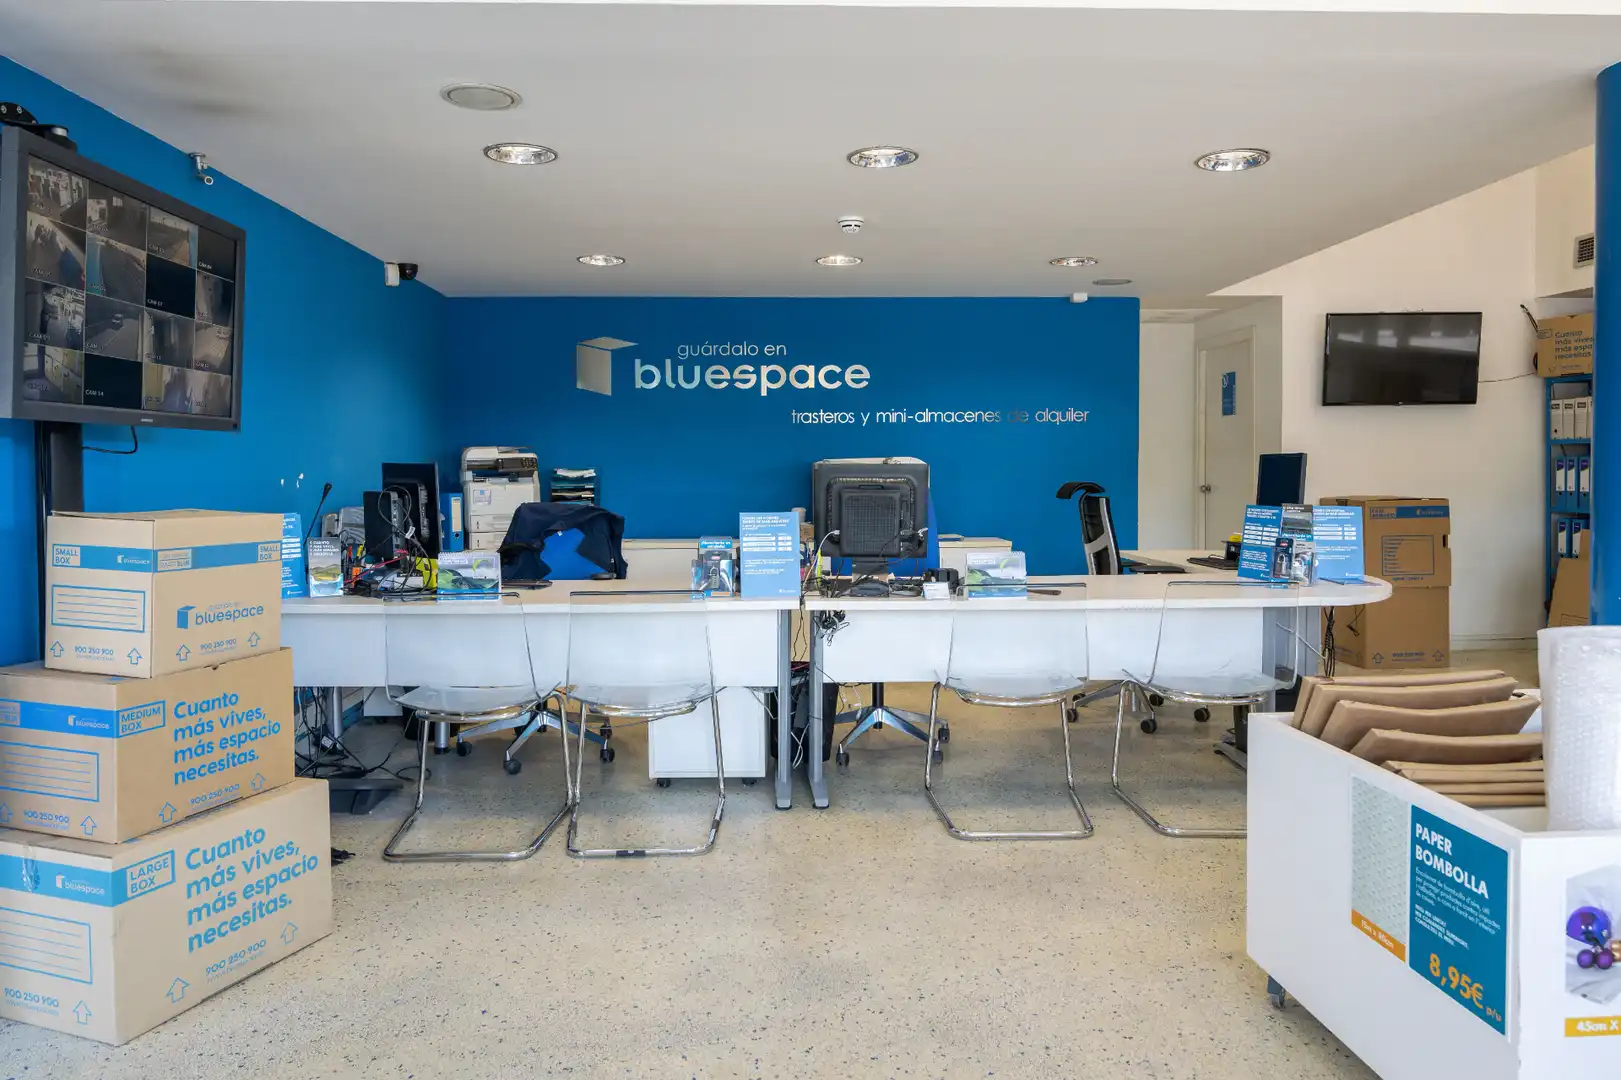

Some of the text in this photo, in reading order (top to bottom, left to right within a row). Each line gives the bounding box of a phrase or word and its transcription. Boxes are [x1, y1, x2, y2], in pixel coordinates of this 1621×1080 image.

[677, 340, 787, 360] guárdalo en
[634, 358, 871, 396] bluespace
[791, 407, 1090, 427] trasteros y mini-almacenes de alquiler
[55, 547, 79, 557] SMALL
[55, 556, 70, 565] BOX
[195, 605, 264, 626] bluespace
[74, 645, 114, 656] 900 250 900
[200, 642, 213, 651] 900
[121, 705, 161, 723] MEDIUM
[173, 691, 240, 720] Cuanto
[121, 720, 142, 733] BOX
[173, 706, 267, 743] más vives,
[173, 719, 282, 765] más espacio
[173, 748, 260, 787] necesitas.
[39, 811, 54, 821] 250
[184, 827, 267, 871] Cuanto
[1415, 822, 1453, 856] PAPER
[129, 857, 170, 881] LARGE
[185, 839, 301, 900] más vives,
[1415, 844, 1489, 900] BOMBOLLA
[130, 873, 157, 894] BOX
[186, 854, 319, 927] más espacio
[187, 892, 293, 955] necesitas.
[1429, 952, 1484, 1009] 8,95€
[4, 986, 22, 999] 900
[23, 990, 40, 1003] 250
[41, 994, 60, 1008] 900
[1576, 1019, 1620, 1032] 45cm X
